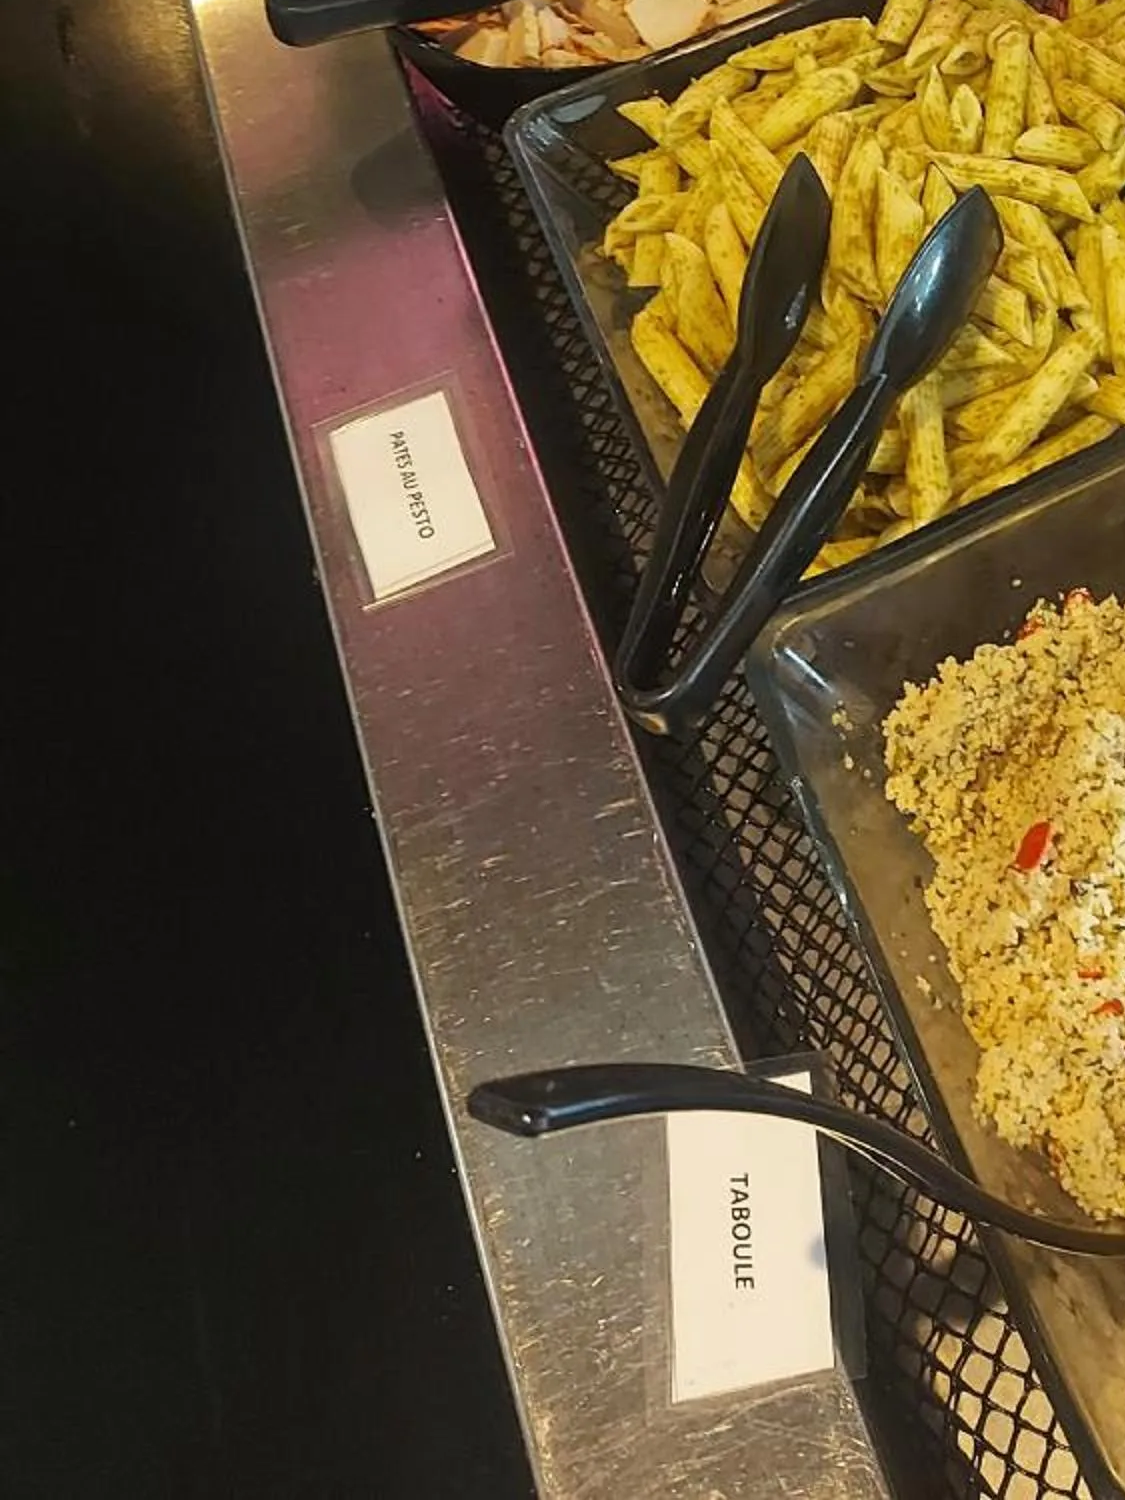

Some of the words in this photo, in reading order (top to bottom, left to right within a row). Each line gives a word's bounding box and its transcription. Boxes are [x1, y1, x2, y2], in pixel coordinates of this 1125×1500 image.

[389, 431, 413, 469] PATES
[400, 471, 419, 490] AU
[406, 491, 435, 539] PESTO
[730, 1172, 755, 1290] TABOULE
